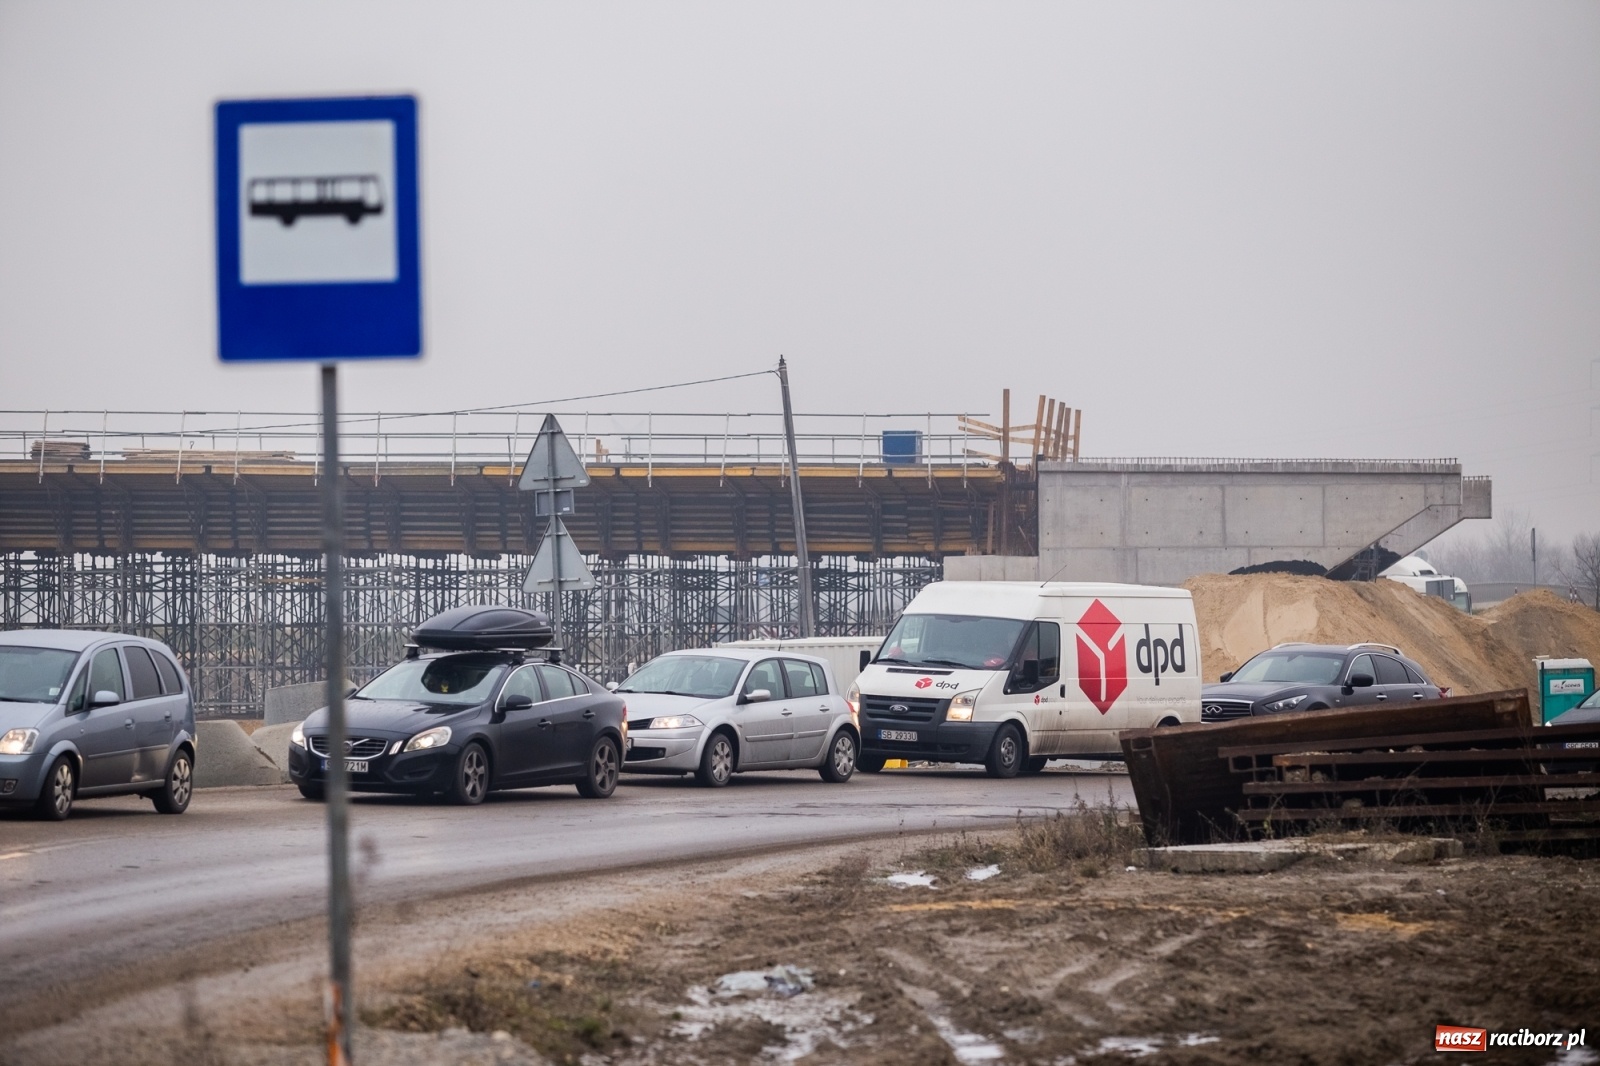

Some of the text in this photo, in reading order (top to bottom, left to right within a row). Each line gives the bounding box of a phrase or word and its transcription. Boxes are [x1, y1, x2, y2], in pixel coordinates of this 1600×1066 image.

[1136, 623, 1186, 686] dpd
[935, 680, 960, 690] dpd
[882, 730, 917, 740] SB 2933U
